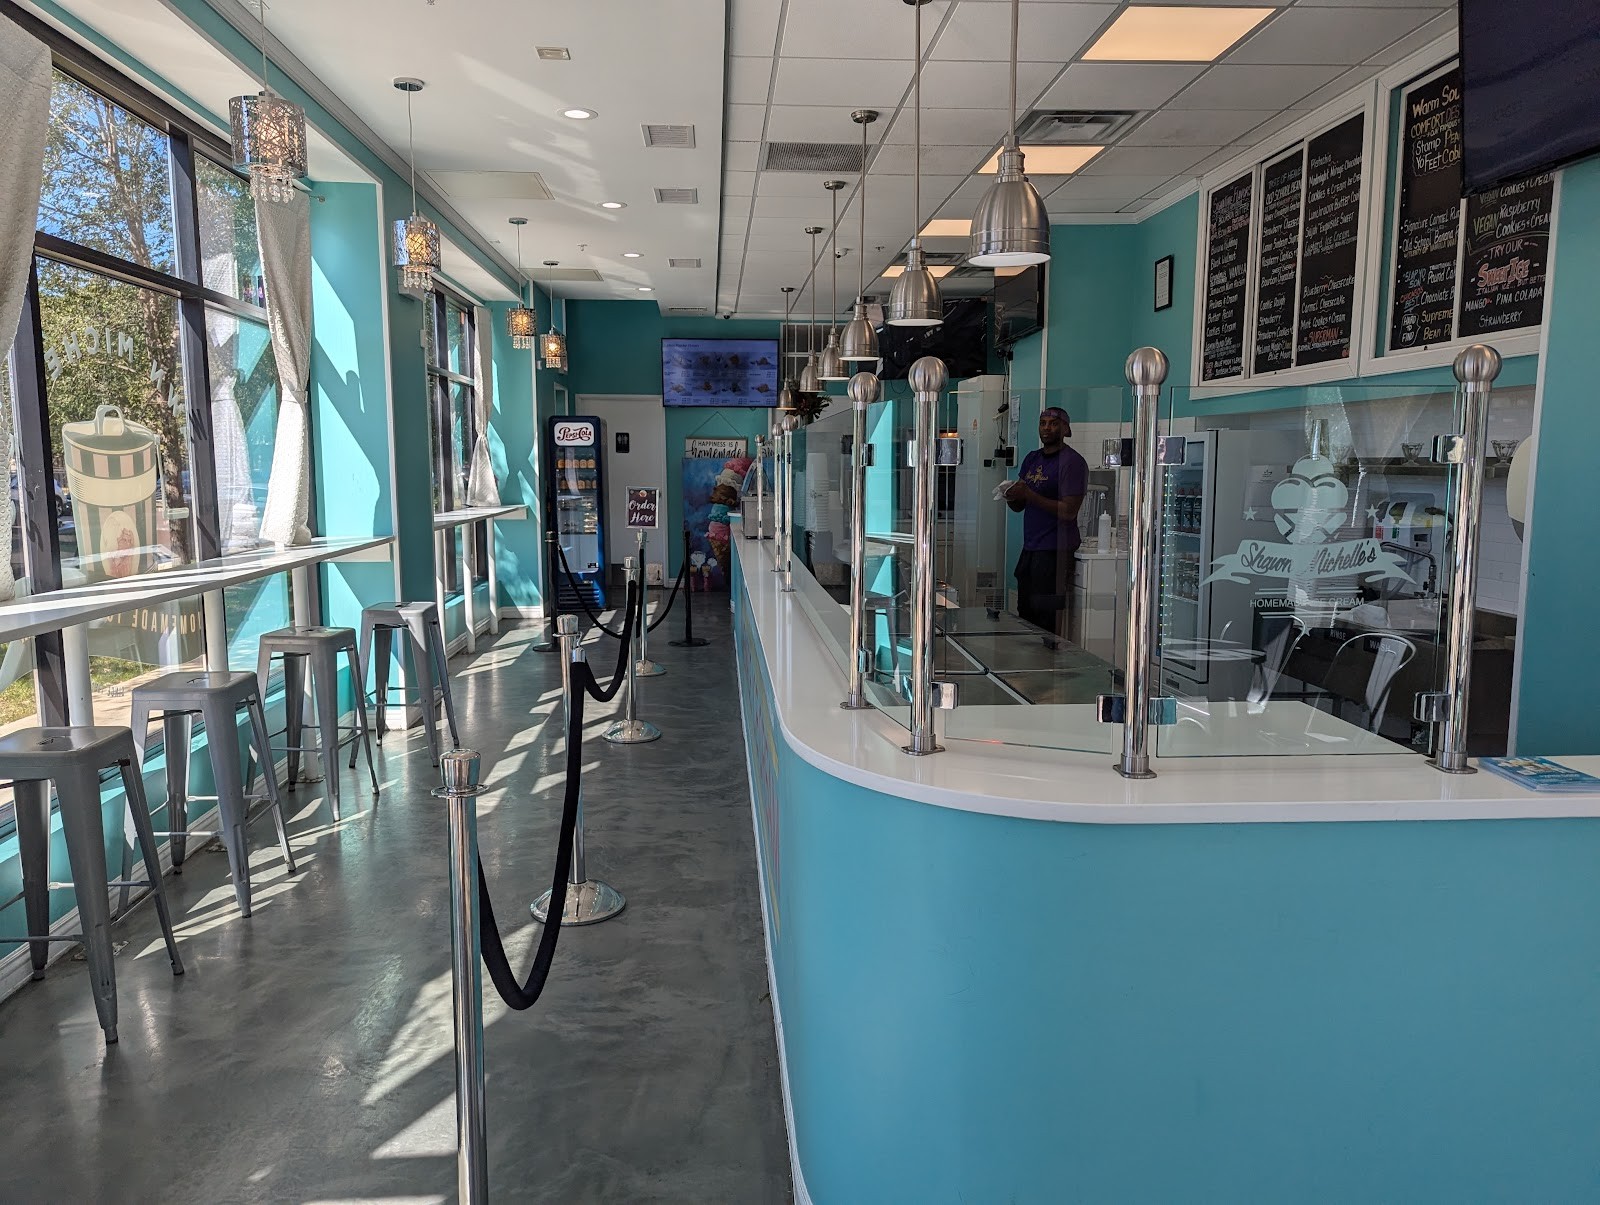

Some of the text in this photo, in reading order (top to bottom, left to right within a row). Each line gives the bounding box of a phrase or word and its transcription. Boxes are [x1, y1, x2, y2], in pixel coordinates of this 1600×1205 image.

[1413, 98, 1440, 118] Warm
[1410, 111, 1446, 139] COMFORT
[1514, 286, 1543, 302] COLADA
[629, 499, 657, 512] Order
[630, 512, 655, 523] Here
